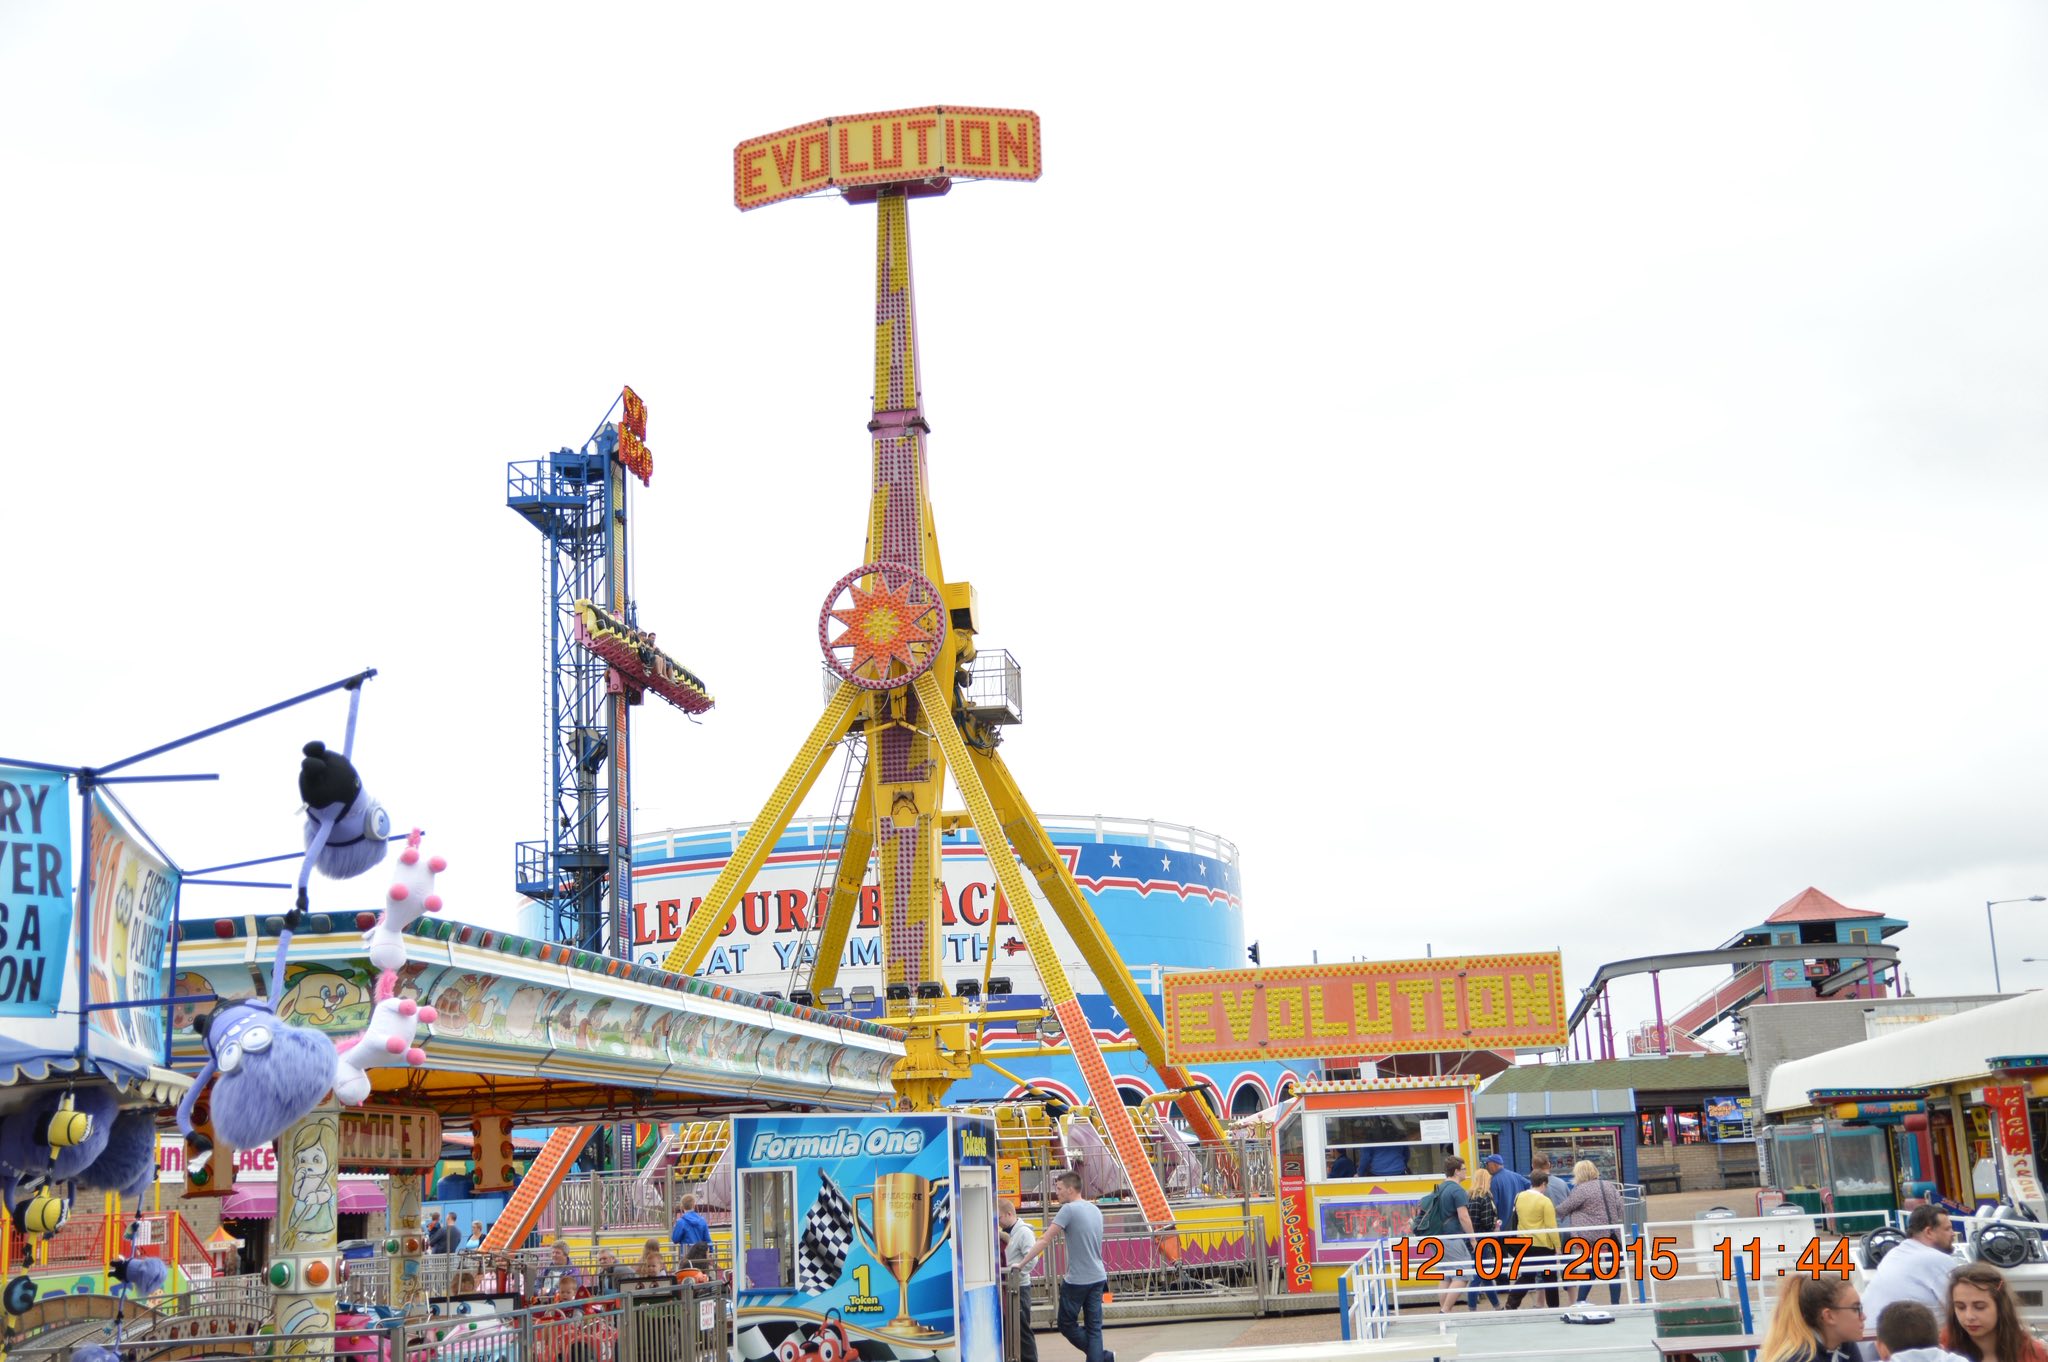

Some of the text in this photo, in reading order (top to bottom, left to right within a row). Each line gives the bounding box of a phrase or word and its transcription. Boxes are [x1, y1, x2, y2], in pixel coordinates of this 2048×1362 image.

[743, 118, 1029, 199] EVOLUTION
[0, 841, 64, 898] ER
[17, 905, 41, 951] A
[130, 917, 164, 972] PLAYER
[1177, 973, 1552, 1044] EVOLUTION
[340, 1113, 412, 1158] RMULE
[751, 1128, 922, 1162] Formula One
[961, 1129, 987, 1157] Tokens
[1285, 1162, 1300, 1171] 2
[1281, 1195, 1312, 1286] EVOLUTION
[848, 1295, 879, 1305] Token
[853, 1265, 870, 1297] 1
